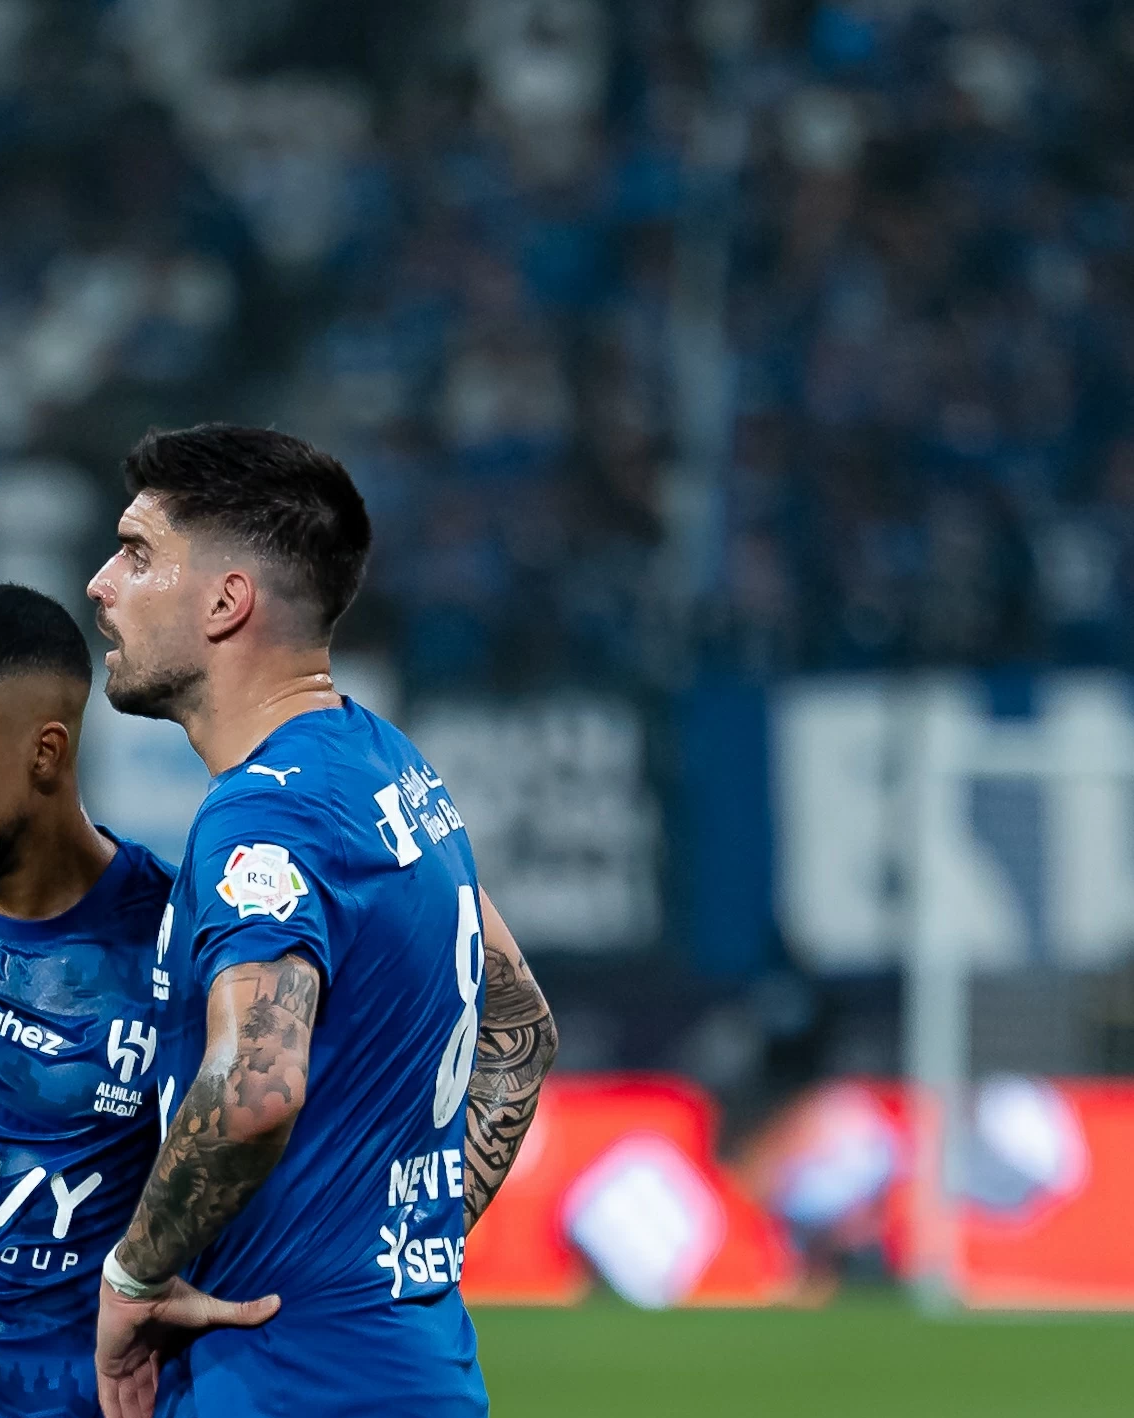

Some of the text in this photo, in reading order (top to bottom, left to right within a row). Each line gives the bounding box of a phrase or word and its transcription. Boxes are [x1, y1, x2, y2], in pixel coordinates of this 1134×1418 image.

[247, 872, 276, 888] RSL
[433, 885, 485, 1128] 8
[96, 1081, 142, 1105] ALHILAL
[93, 1097, 137, 1118] الهلال
